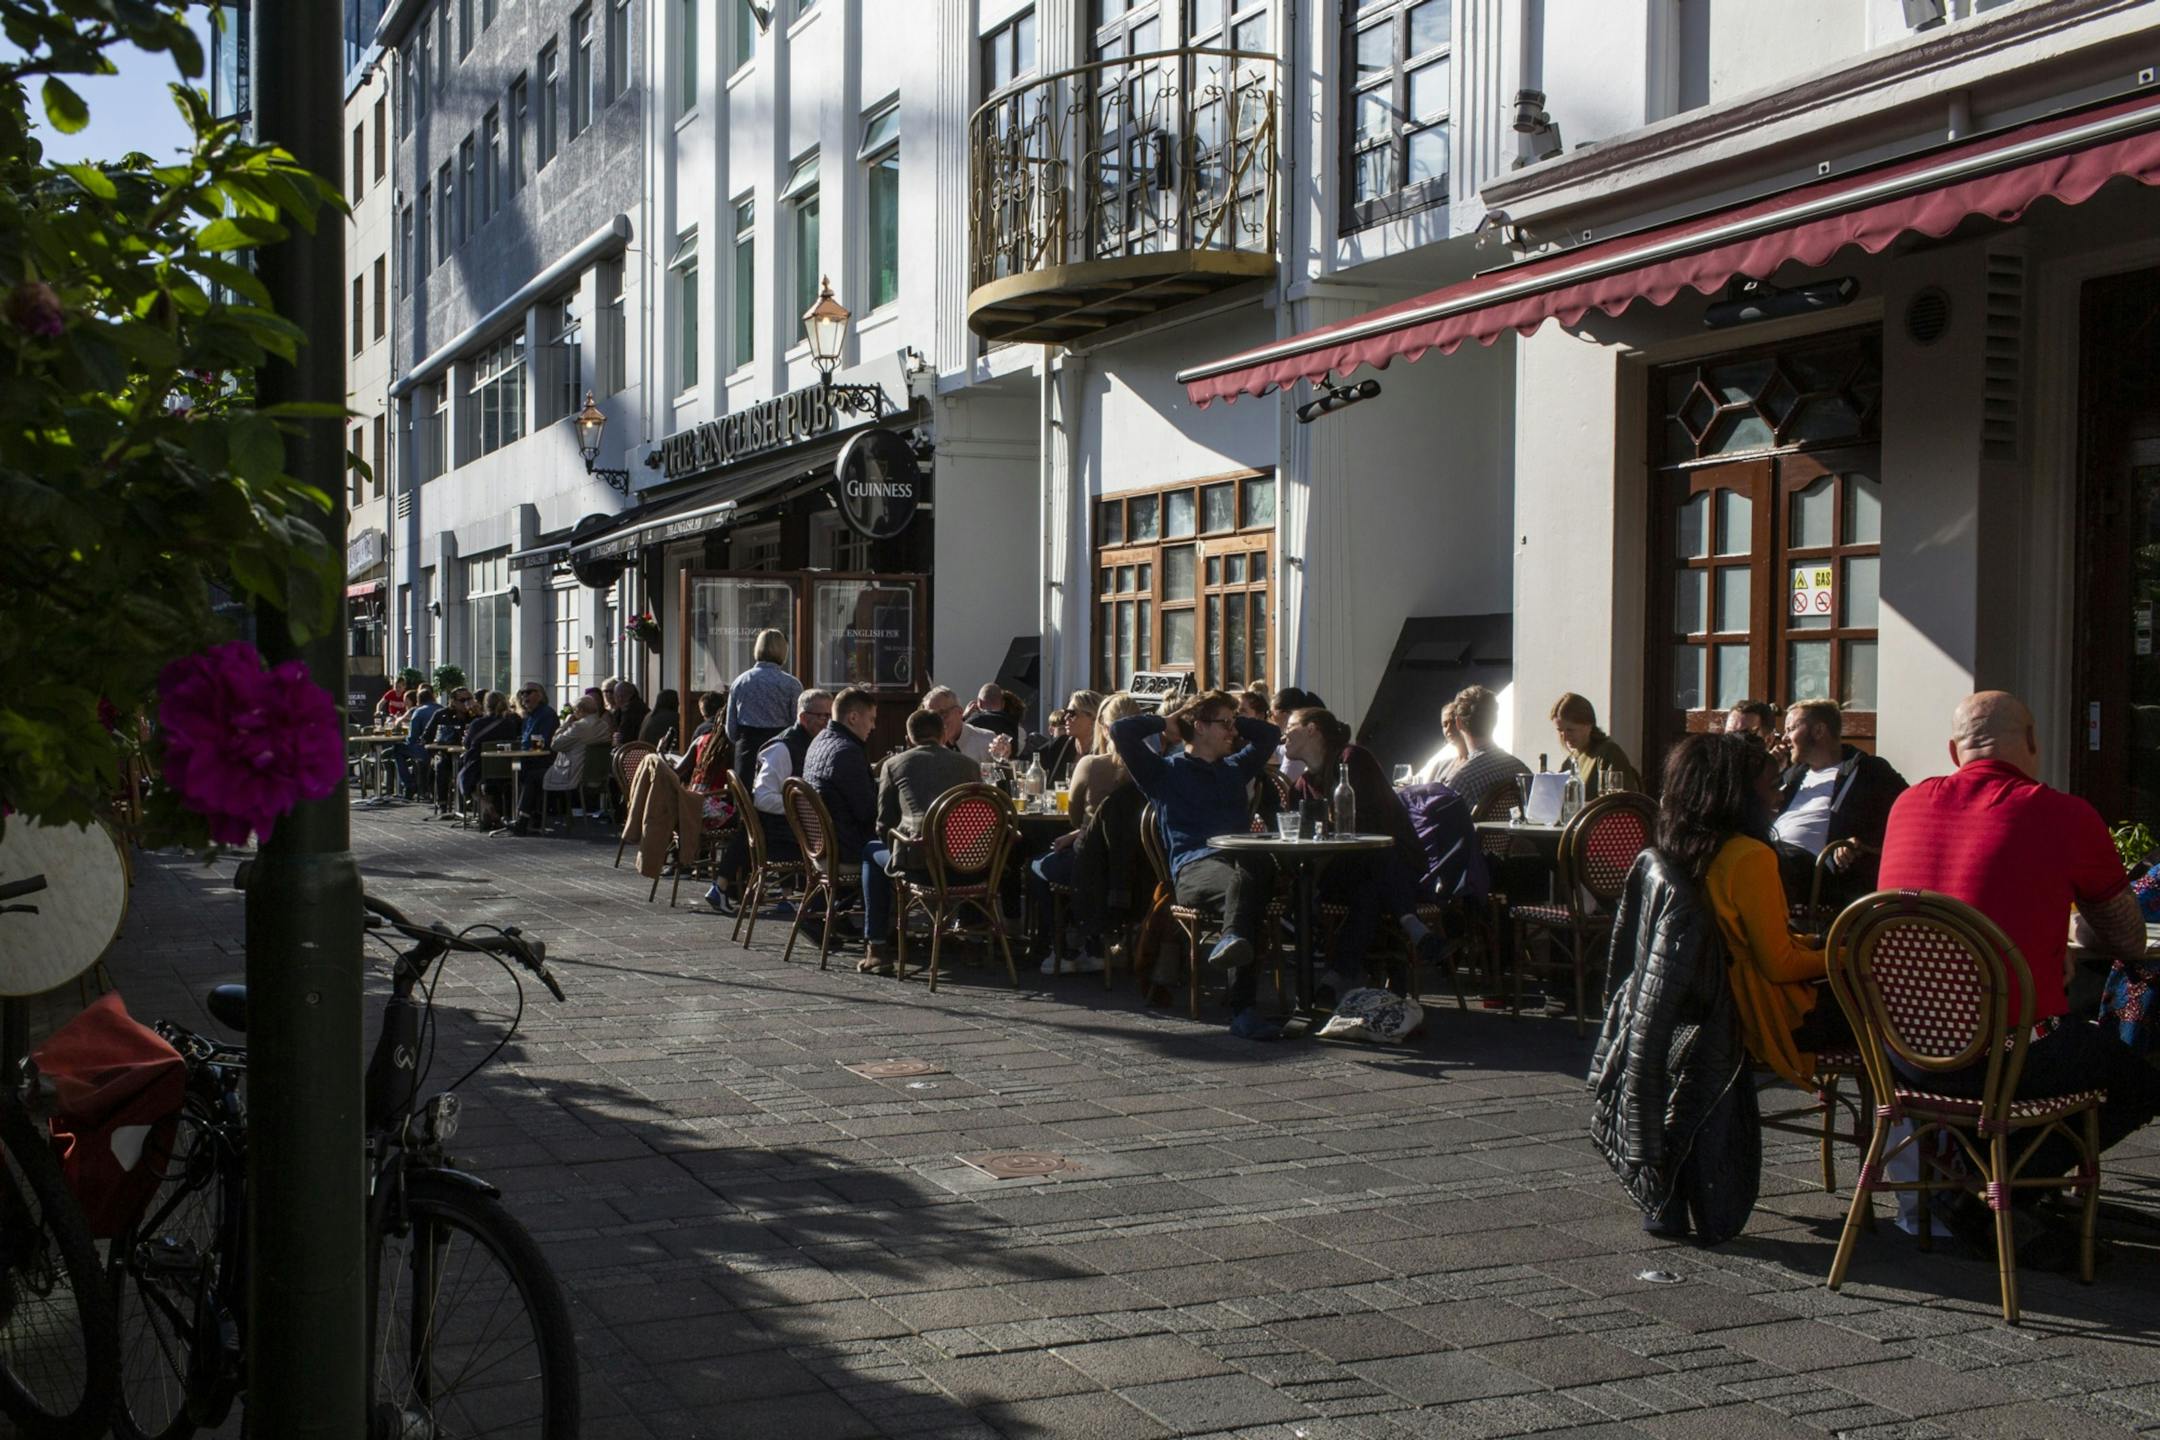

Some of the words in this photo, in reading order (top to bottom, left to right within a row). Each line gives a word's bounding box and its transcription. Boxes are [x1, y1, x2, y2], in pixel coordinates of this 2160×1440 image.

[662, 430, 695, 478] THE
[697, 398, 781, 466] ENGLISH
[783, 384, 830, 439] PUB
[846, 480, 913, 498] GUINNESS
[1815, 572, 1831, 587] GAS
[846, 628, 884, 638] ENGLISH
